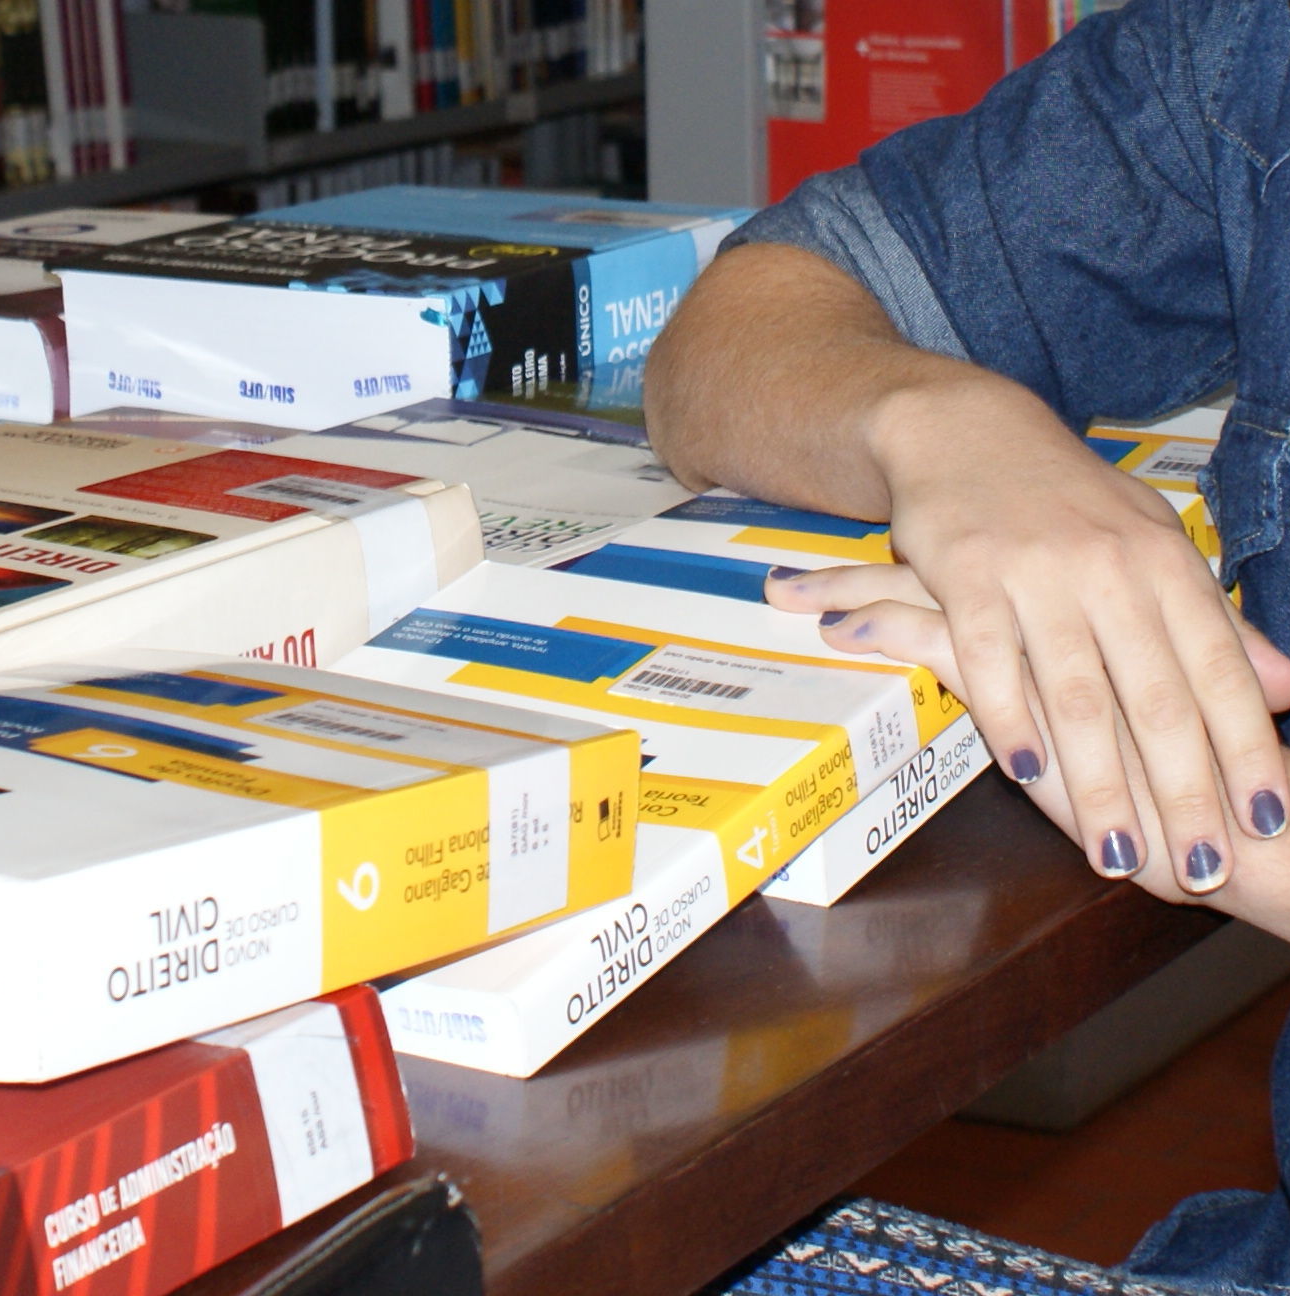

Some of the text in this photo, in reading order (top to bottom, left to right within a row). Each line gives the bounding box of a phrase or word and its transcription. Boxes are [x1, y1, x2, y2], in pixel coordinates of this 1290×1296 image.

[401, 624, 453, 640] atualizada
[889, 745, 936, 796] CIVIL
[939, 750, 952, 772] DE
[940, 754, 970, 791] NOVO
[785, 770, 818, 809] Filho
[789, 784, 845, 839] Gagliano
[865, 774, 939, 855] DIREITO
[404, 839, 445, 868] Filho
[736, 826, 769, 870] 4
[337, 861, 381, 912] 6
[403, 869, 472, 906] Gagliano
[653, 874, 711, 933] CURSO DE
[149, 896, 219, 947] CIVIL
[225, 901, 299, 940] CURSO DE
[589, 903, 648, 965] CIVIL
[655, 914, 693, 954] NOVO
[108, 938, 220, 1004] DIREITO
[224, 938, 271, 968] NOVO
[566, 936, 654, 1025] DIREITO
[43, 1185, 102, 1249] CURSO
[116, 1120, 237, 1210] ADMINISTRAÇÃO
[51, 1217, 147, 1292] FINANCEIRA
